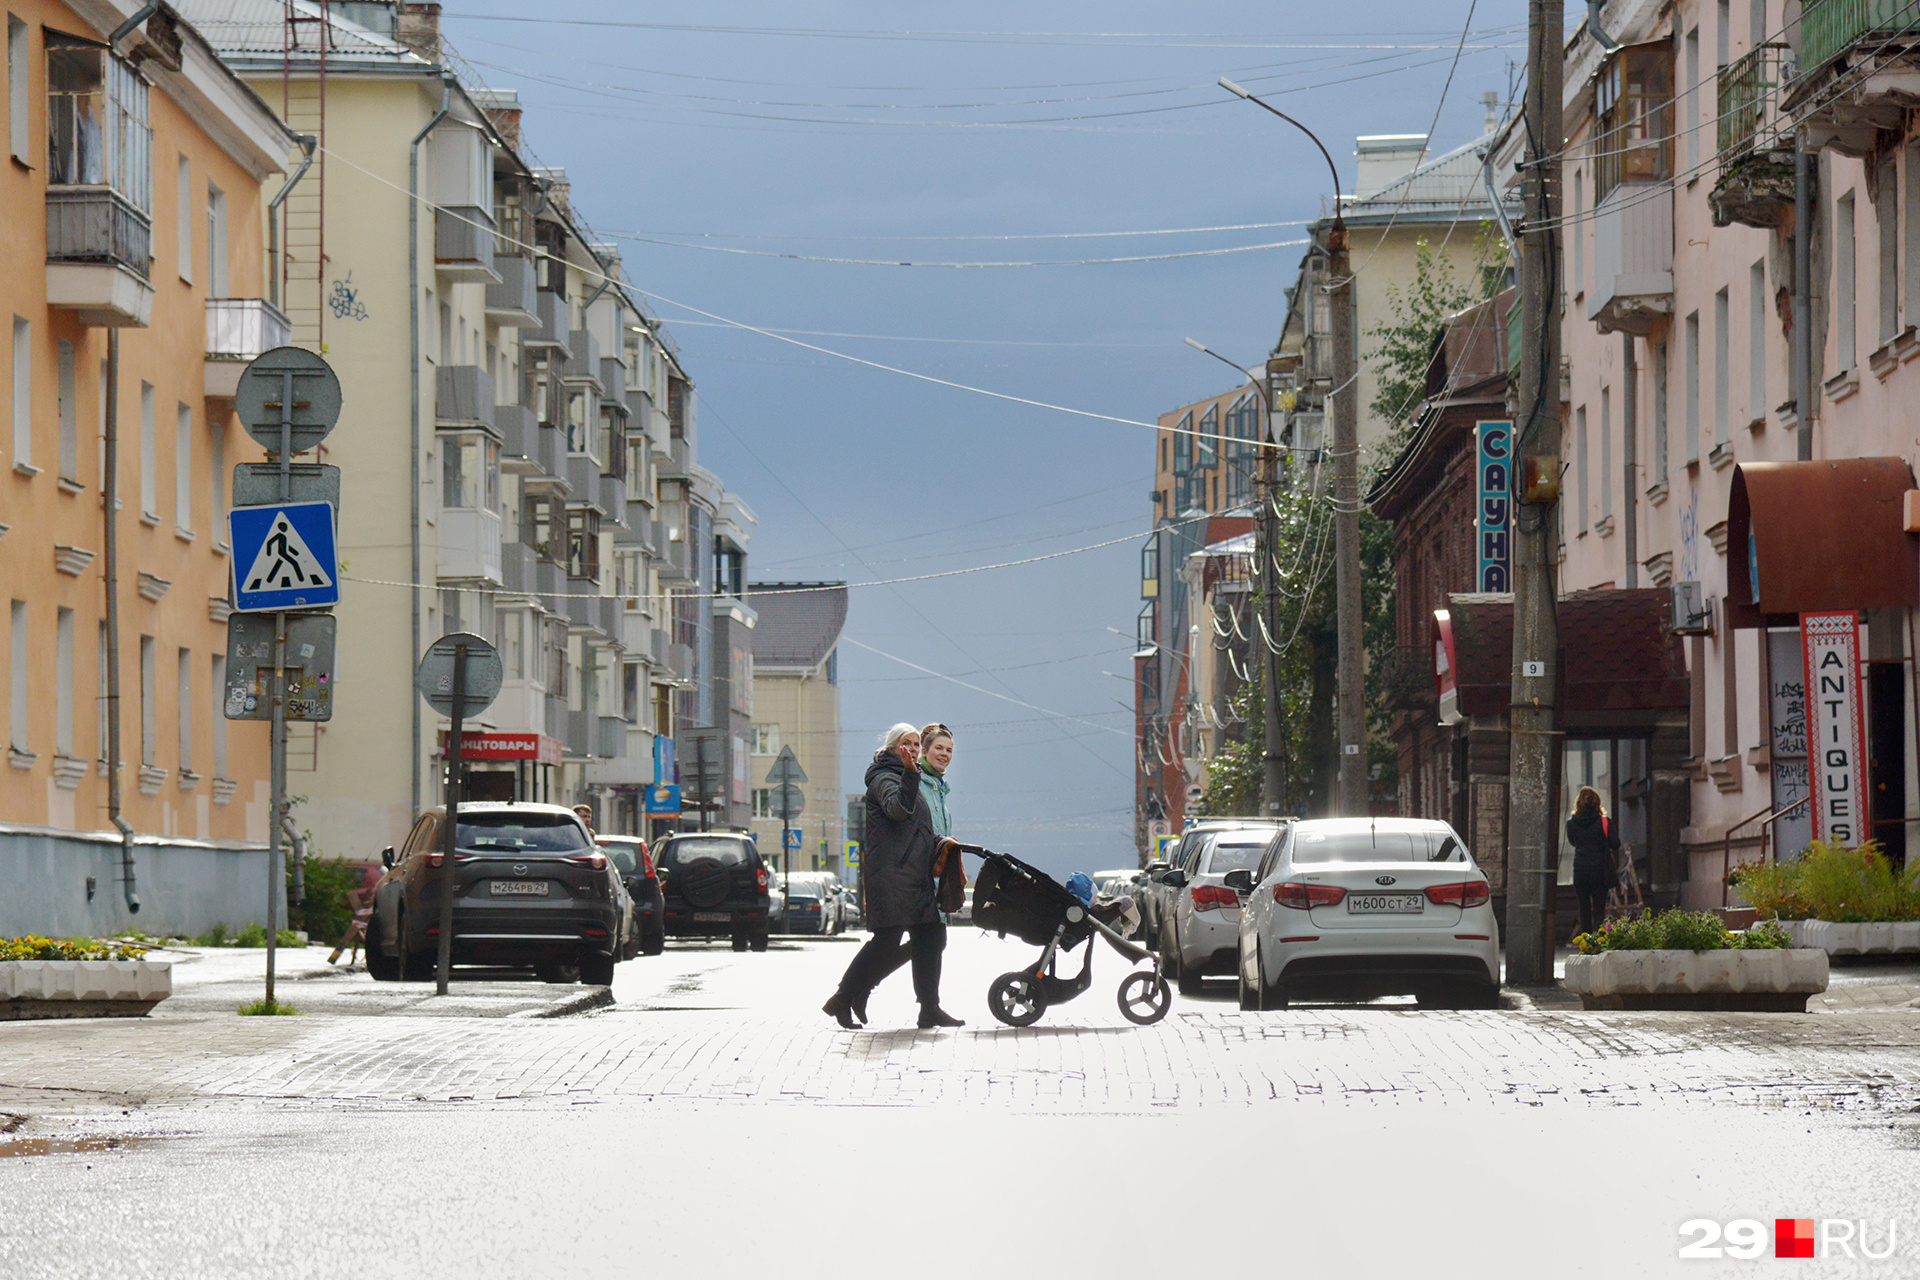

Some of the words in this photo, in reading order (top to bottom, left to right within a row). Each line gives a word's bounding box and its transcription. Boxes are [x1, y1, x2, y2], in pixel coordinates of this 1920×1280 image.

[1482, 429, 1509, 593] САУНА
[1529, 663, 1537, 675] 9
[447, 740, 535, 751] НЦТОВАРЫ
[1820, 650, 1851, 842] ANTIQUES
[1378, 876, 1394, 885] KIA
[1353, 897, 1403, 909] М600СТ
[1406, 896, 1419, 906] 29
